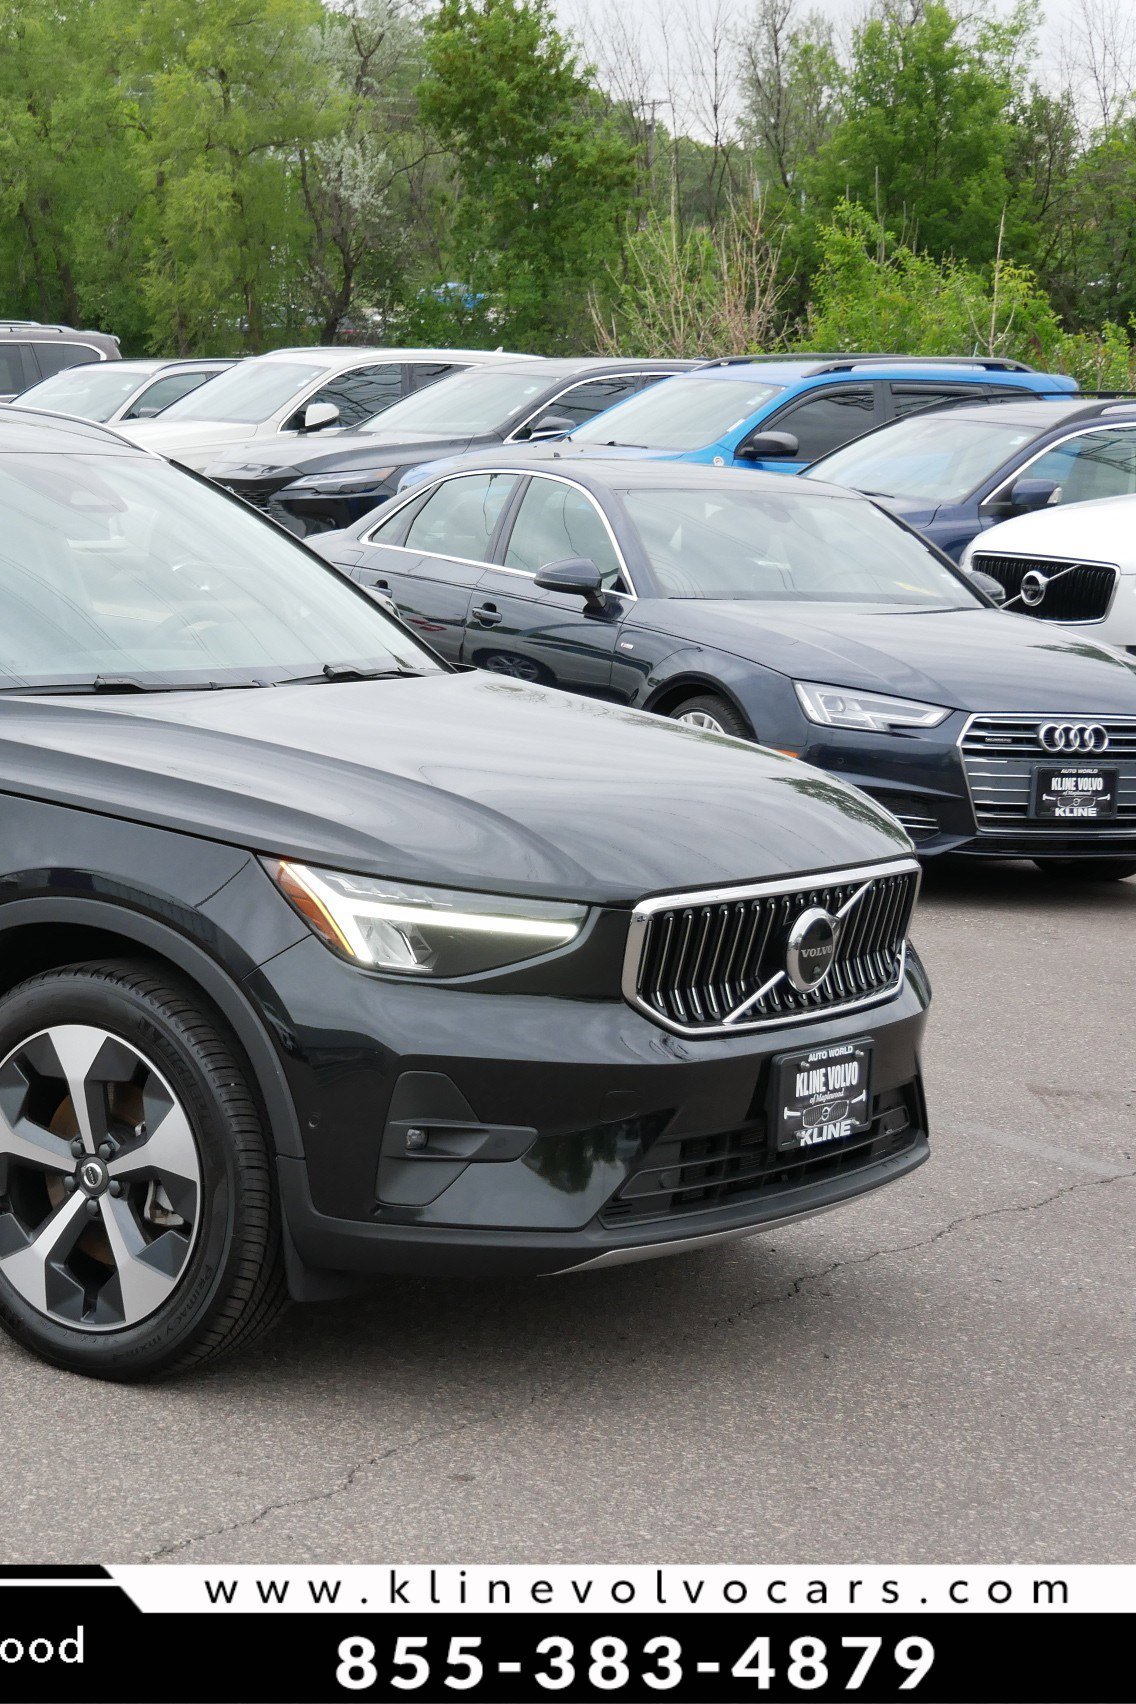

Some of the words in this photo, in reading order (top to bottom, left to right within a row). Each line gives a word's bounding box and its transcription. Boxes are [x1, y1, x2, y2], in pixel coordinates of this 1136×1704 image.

[1051, 777, 1077, 791] KLINE
[1077, 777, 1103, 791] VOLVO
[1055, 807, 1097, 817] KLINE
[801, 945, 833, 958] VOLVO
[808, 1051, 828, 1062] AUTO
[829, 1045, 854, 1058] WORLD
[796, 1068, 826, 1097] KLINE
[827, 1061, 858, 1090] VOLVO
[800, 1120, 851, 1146] KLINE
